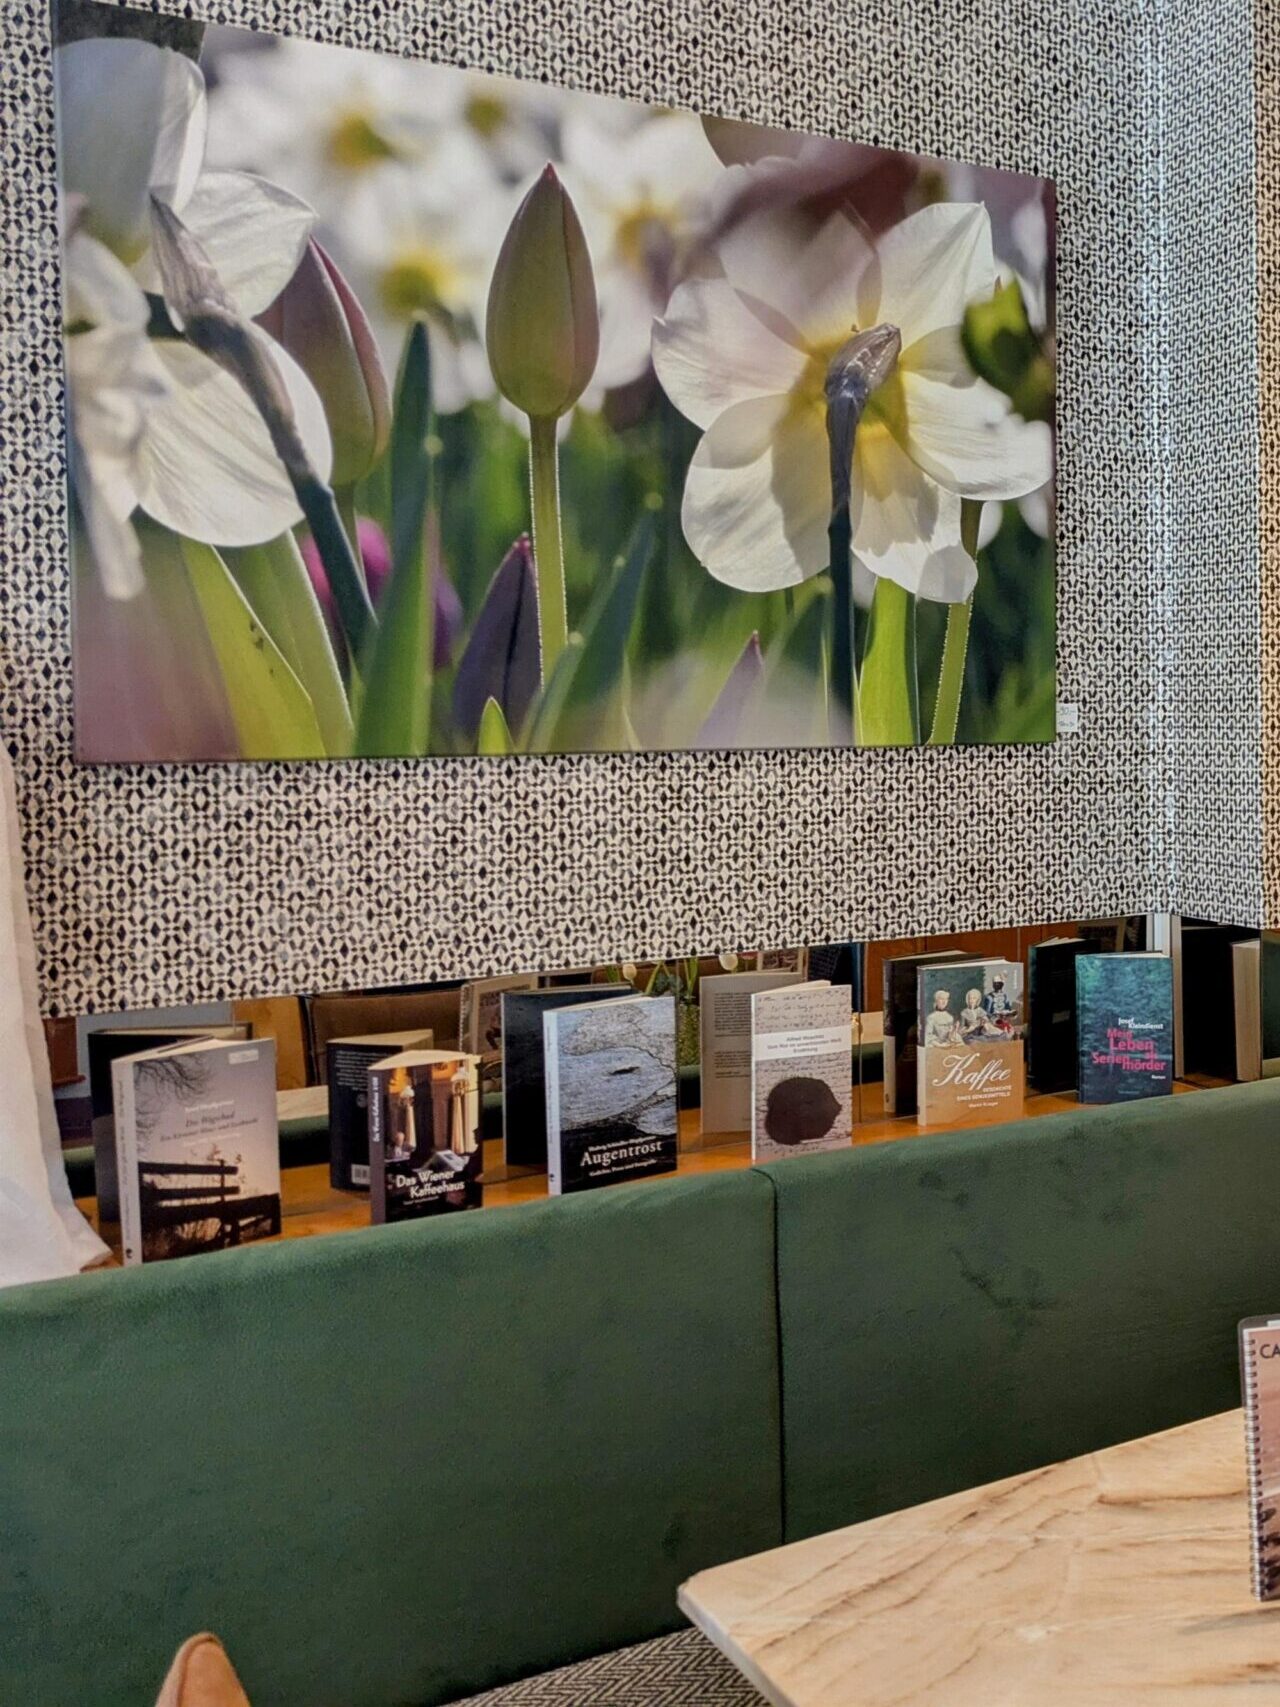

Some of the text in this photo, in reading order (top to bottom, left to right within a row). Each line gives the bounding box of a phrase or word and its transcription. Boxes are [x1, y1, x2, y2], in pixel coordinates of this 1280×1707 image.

[1109, 1037, 1154, 1051] Leben
[932, 1051, 1012, 1091] Kaffee
[1122, 1059, 1167, 1071] mörder
[579, 1141, 664, 1167] Augentrost
[395, 1169, 456, 1188] Das Wiener
[409, 1181, 466, 1199] Kaffeehaus
